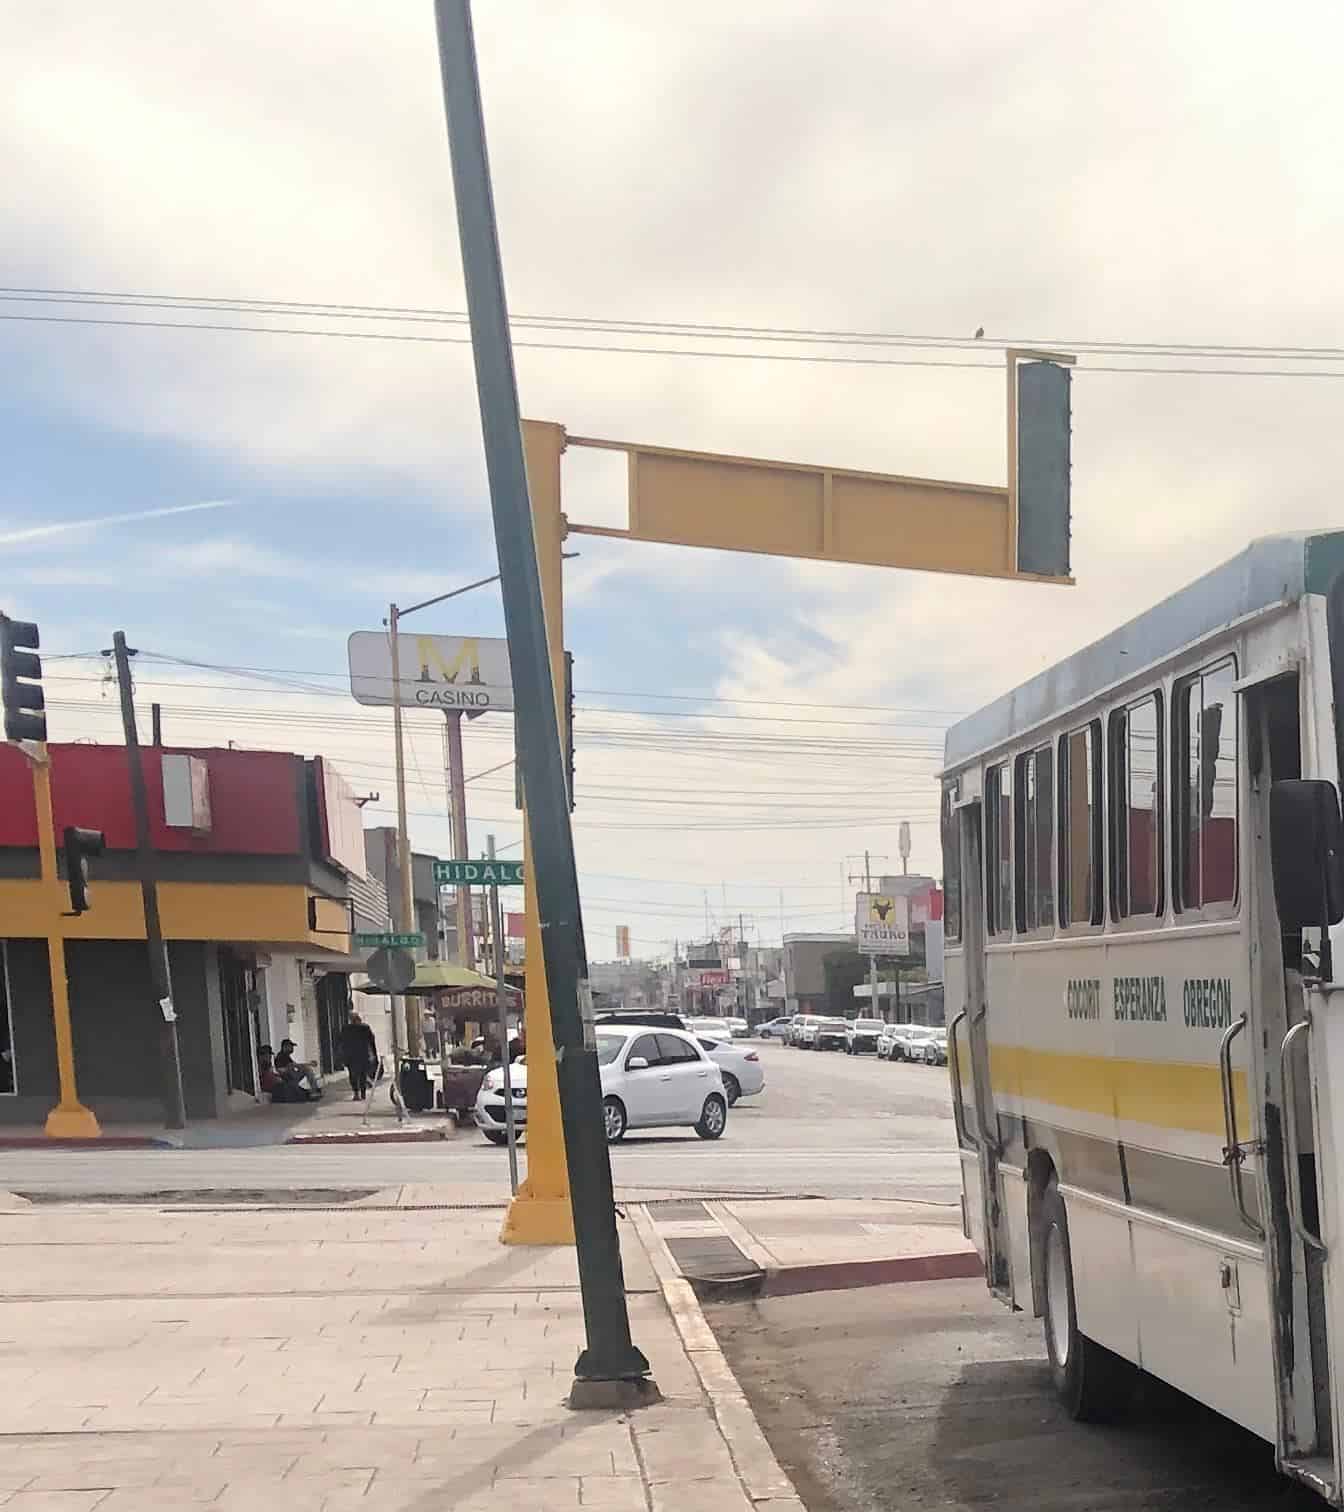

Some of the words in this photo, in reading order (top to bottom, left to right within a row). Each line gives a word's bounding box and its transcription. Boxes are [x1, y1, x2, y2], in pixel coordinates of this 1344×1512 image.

[415, 689, 490, 707] CASINO
[441, 990, 517, 1008] BURRITS
[1113, 976, 1168, 1022] ESPERANZA
[1183, 978, 1232, 1028] OBREGON
